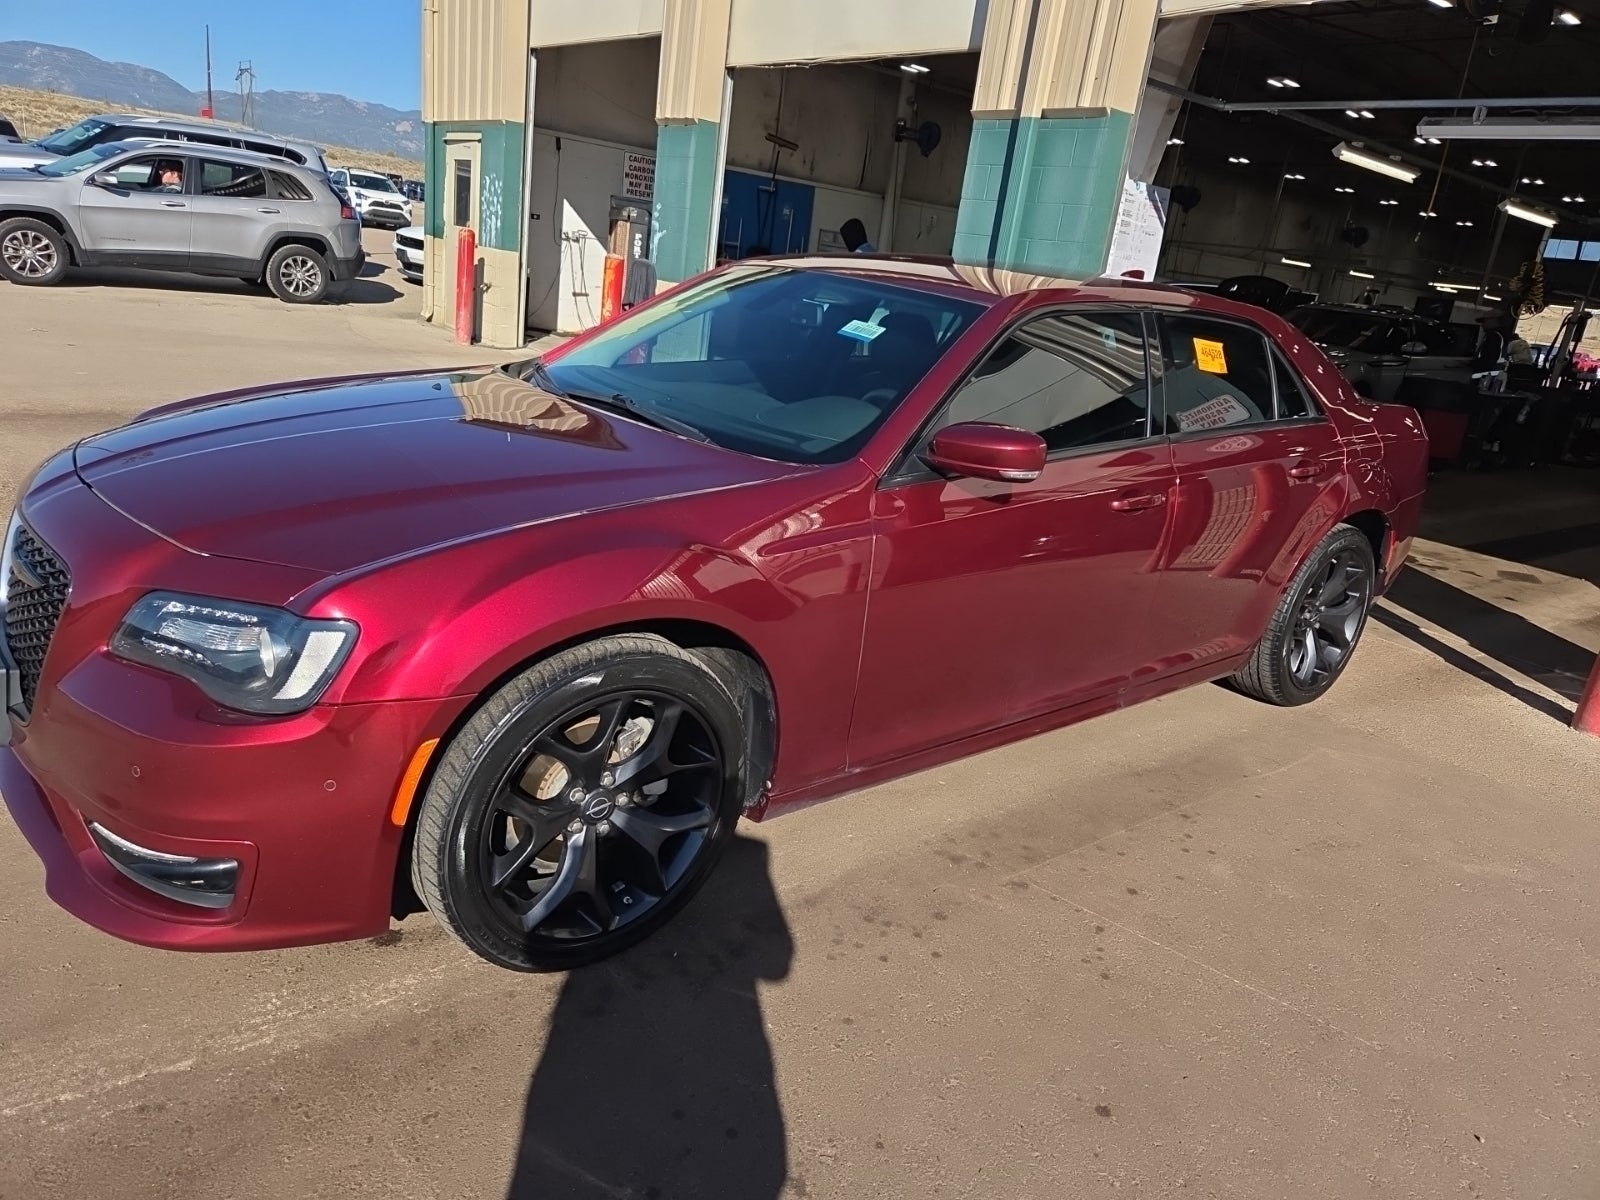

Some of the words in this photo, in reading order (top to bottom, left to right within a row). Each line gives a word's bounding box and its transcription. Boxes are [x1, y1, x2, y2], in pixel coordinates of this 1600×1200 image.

[629, 155, 656, 166] CAUTION
[629, 165, 655, 175] CARBON
[625, 172, 655, 182] MONOXID
[628, 180, 642, 189] MAY
[644, 183, 653, 191] BE
[626, 188, 653, 199] PRESENT
[634, 233, 642, 259] PORT
